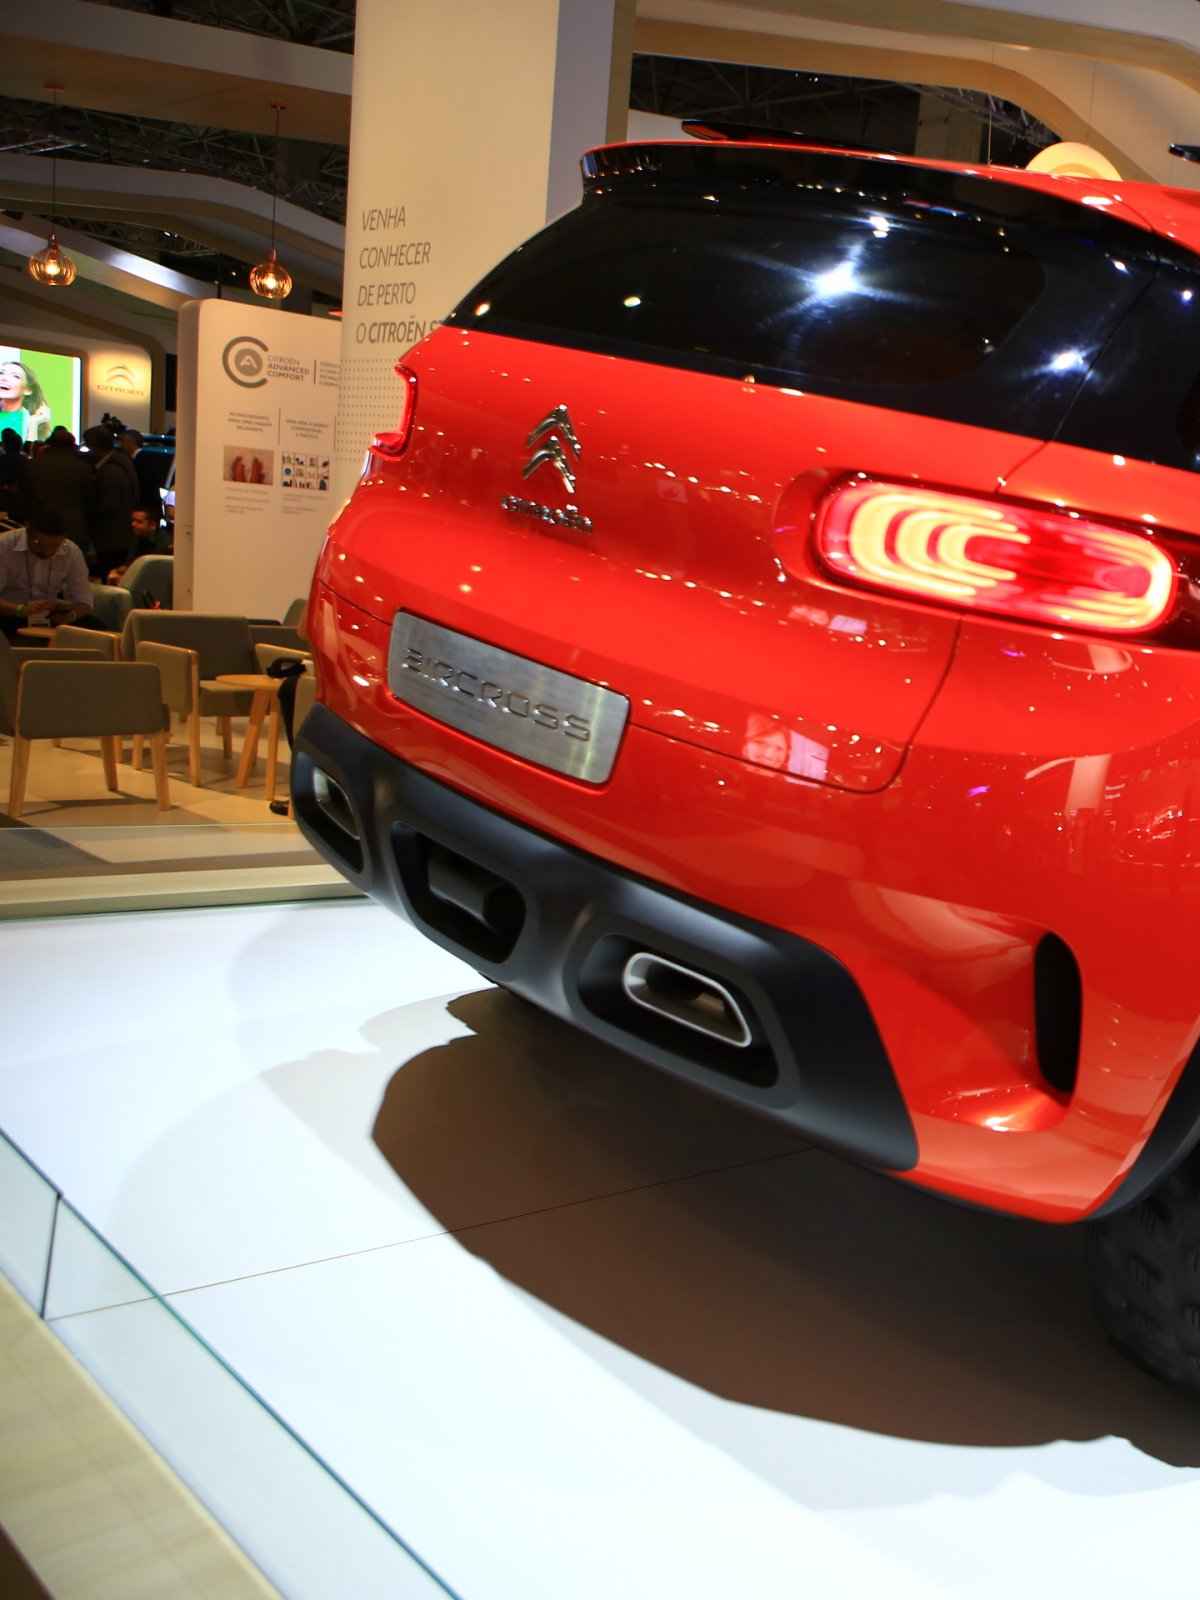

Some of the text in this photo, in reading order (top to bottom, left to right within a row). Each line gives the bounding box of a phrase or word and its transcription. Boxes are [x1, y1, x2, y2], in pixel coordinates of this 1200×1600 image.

[362, 205, 406, 231] VENHA
[359, 242, 431, 269] CONHECER
[357, 282, 416, 306] DE PERTO
[356, 322, 367, 344] O
[368, 315, 427, 343] CITROËN
[267, 363, 310, 375] ADVANCED
[267, 370, 305, 381] COMFORT
